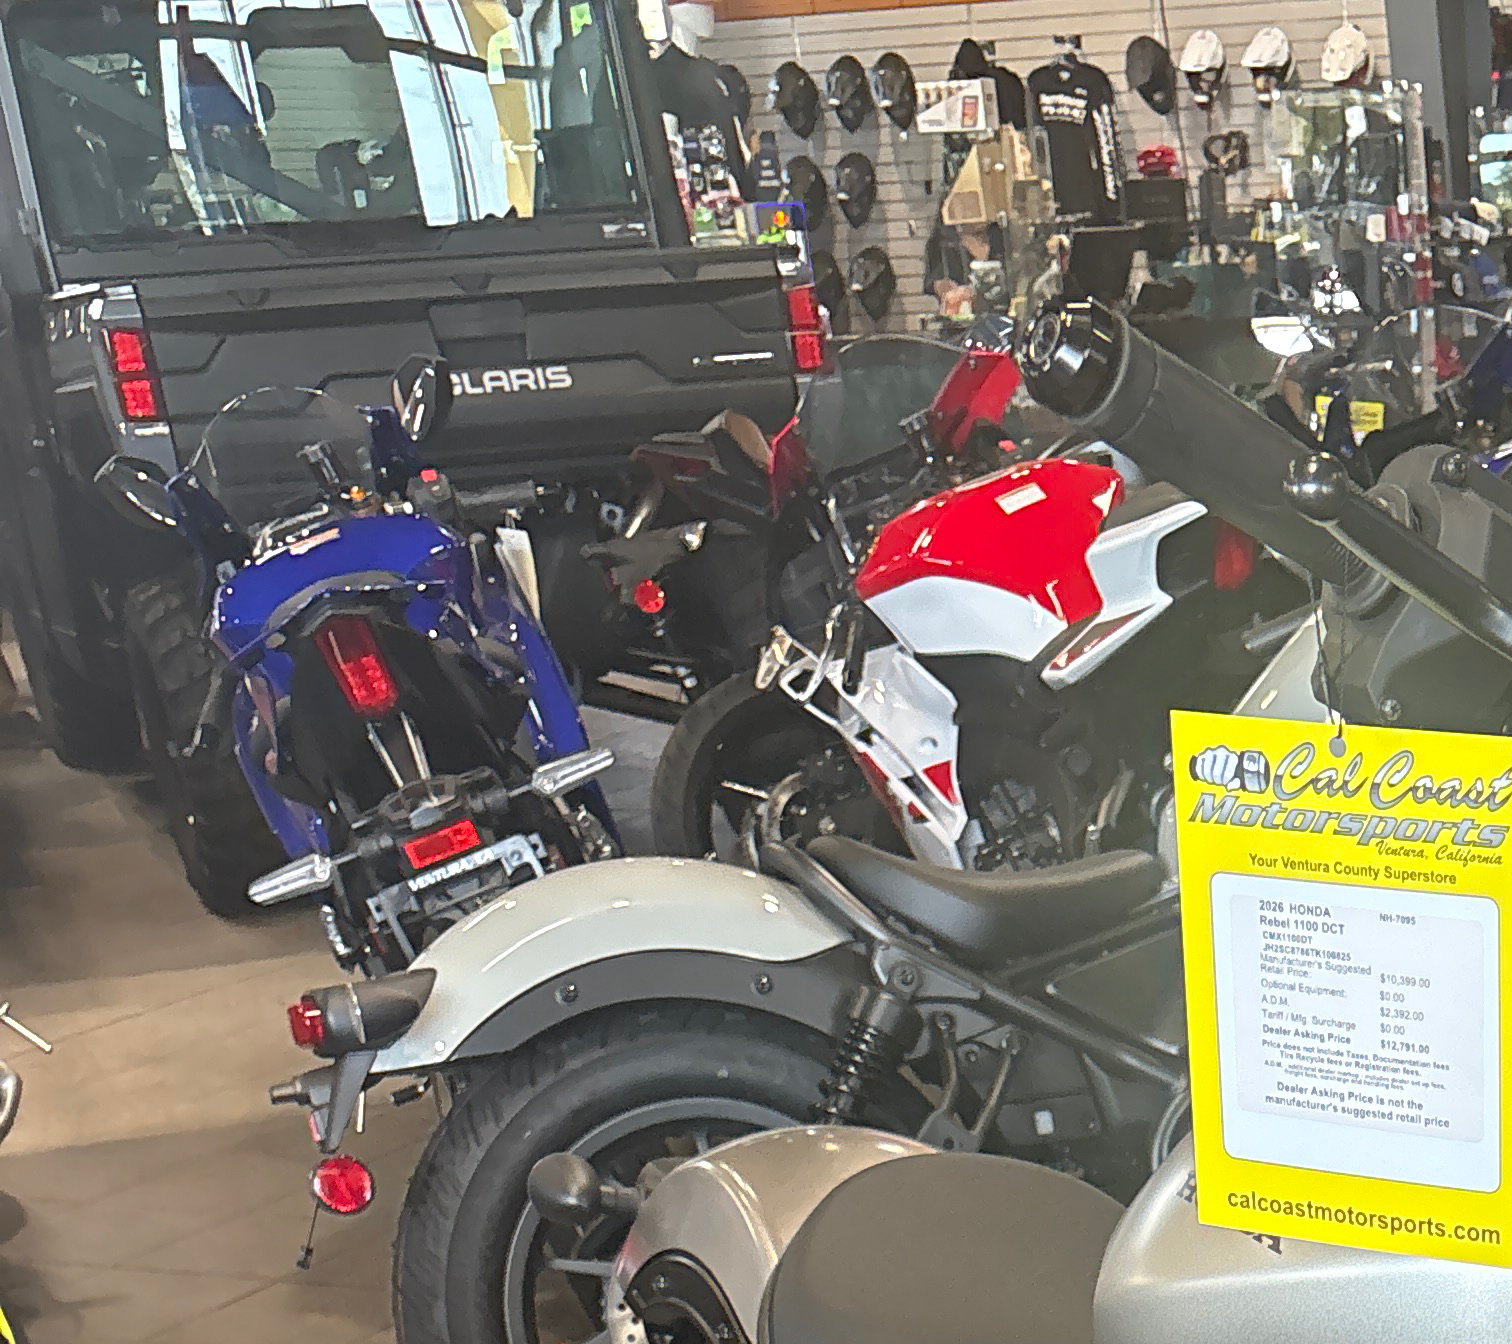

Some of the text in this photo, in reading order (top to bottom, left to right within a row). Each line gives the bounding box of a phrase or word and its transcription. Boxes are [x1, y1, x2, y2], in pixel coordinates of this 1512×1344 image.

[450, 365, 573, 396] LARIS
[1273, 742, 1369, 801] Cal
[1188, 791, 1512, 849] Motorsports
[1375, 840, 1504, 868] Ventura, California
[1248, 853, 1457, 885] Your Ventura County Superstore
[1259, 899, 1332, 919] 2026 HONDA
[1259, 914, 1345, 935] Rebel 1100 DCT
[1260, 951, 1372, 977] Manufacturer's Suggested
[1260, 963, 1285, 975] Retail
[1260, 977, 1296, 991] Optional
[1380, 972, 1431, 989] $10,399.00
[1379, 990, 1405, 1003] $0.00
[1311, 1015, 1357, 1032] Surcharge
[1379, 1006, 1424, 1022] $2,392.00
[1262, 1023, 1352, 1045] Dealer Asking Price
[1379, 1022, 1406, 1036] $0.00
[1262, 1039, 1281, 1050] Price
[1316, 1046, 1345, 1058] include
[1372, 1053, 1432, 1069] Documentation
[1380, 1038, 1430, 1055] $12,791.00
[1280, 1050, 1294, 1060] Tire
[1295, 1052, 1325, 1065] Recycle
[1354, 1060, 1401, 1073] Registration
[1276, 1080, 1424, 1111] Dealer Asking Price is not the
[1265, 1095, 1450, 1128] manufacturer's suggested retail price
[1227, 1190, 1502, 1246] calcoastmotorsports.com
